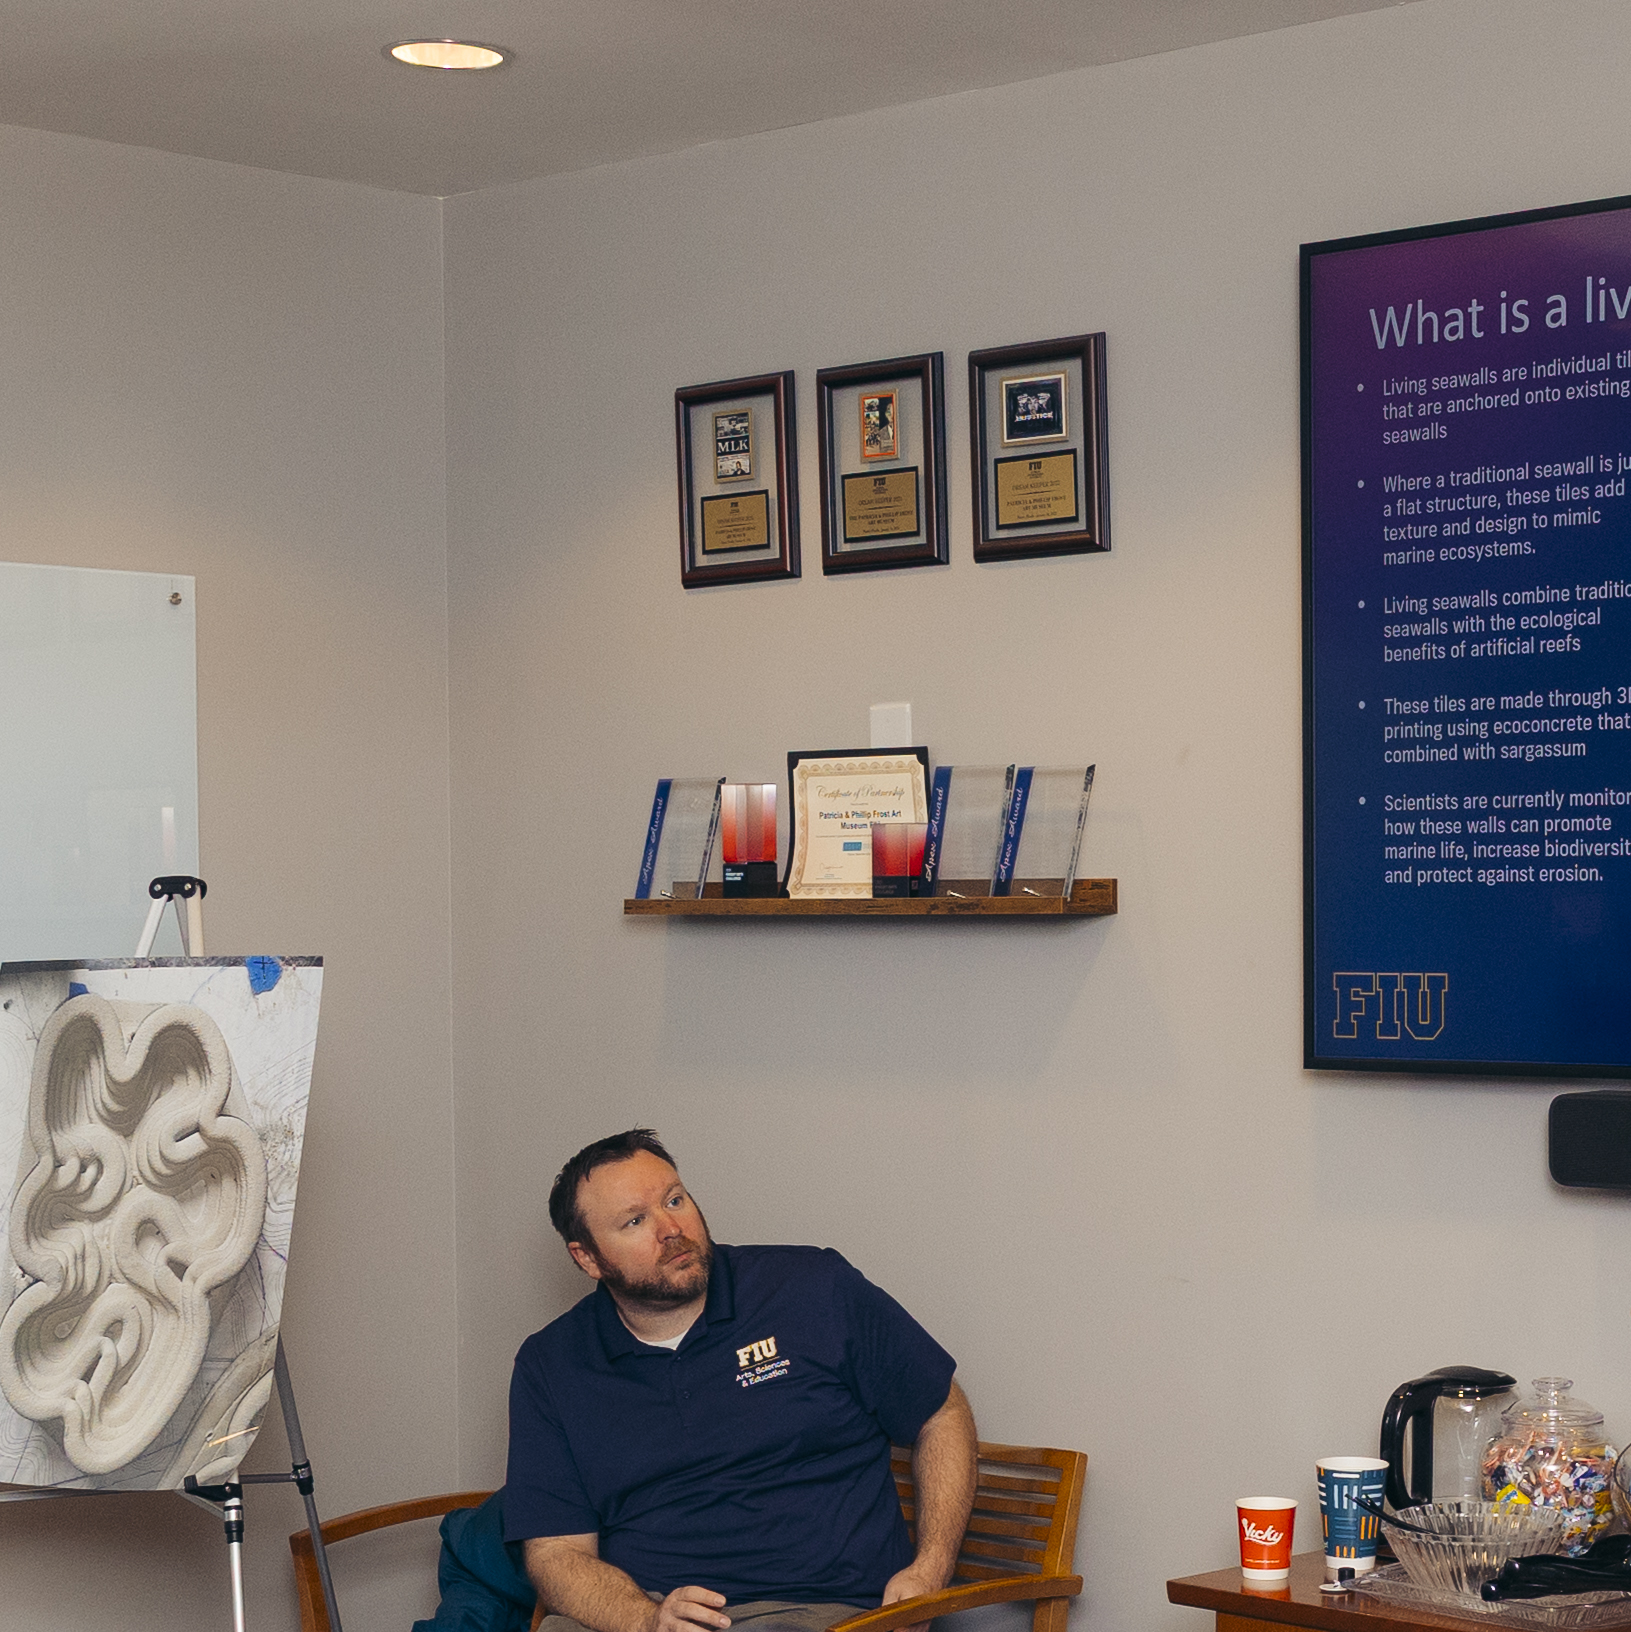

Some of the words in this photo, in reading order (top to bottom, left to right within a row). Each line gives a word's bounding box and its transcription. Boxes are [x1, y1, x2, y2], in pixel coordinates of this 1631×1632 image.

[1369, 298, 1484, 349] What
[1500, 290, 1530, 334] is
[1545, 294, 1567, 329] a
[1383, 376, 1427, 396] Living
[1432, 366, 1498, 390] seawalls
[1501, 369, 1528, 384] are
[1532, 352, 1610, 379] individual
[1382, 402, 1413, 420] that
[1418, 401, 1442, 416] are
[1447, 388, 1519, 413] anchored
[1525, 386, 1561, 405] onto
[1566, 377, 1631, 400] existing
[717, 438, 749, 453] MLK
[1383, 422, 1448, 445] seawalls
[1383, 474, 1431, 493] Where
[1436, 475, 1445, 488] a
[1449, 462, 1529, 487] traditional
[1534, 455, 1594, 479] seawall
[1600, 454, 1613, 472] is
[1383, 504, 1392, 517] a
[1396, 498, 1422, 516] flat
[1426, 494, 1501, 513] structure,
[1506, 488, 1550, 506] these
[1555, 483, 1590, 502] tiles
[1594, 478, 1625, 498] add
[1383, 524, 1438, 541] texture
[1442, 517, 1470, 536] and
[1475, 514, 1527, 535] design
[1532, 513, 1548, 529] to
[1553, 506, 1601, 527] mimic
[1383, 546, 1435, 565] marine
[1439, 541, 1536, 562] ecosystems.
[1384, 595, 1428, 615] Living
[1432, 589, 1498, 611] seawalls
[1502, 585, 1570, 606] combine
[1384, 617, 1448, 638] seawalls
[1452, 615, 1485, 634] with
[1490, 613, 1516, 631] the
[1520, 606, 1601, 631] ecological
[1384, 642, 1446, 662] benefits
[1450, 640, 1466, 658] of
[1470, 636, 1534, 657] artificial
[1540, 633, 1581, 653] reefs
[1383, 697, 1429, 715] These
[1433, 694, 1466, 713] tiles
[1470, 697, 1495, 711] are
[1500, 690, 1544, 709] made
[1548, 686, 1612, 709] through
[1384, 720, 1443, 743] printing
[1447, 718, 1489, 739] using
[1493, 715, 1592, 735] ecoconcrete
[1597, 712, 1631, 730] that
[1384, 743, 1458, 763] combined
[1462, 742, 1495, 760] with
[1500, 742, 1586, 762] sargassum
[819, 811, 843, 820] Patricia
[844, 811, 850, 819] &
[872, 810, 890, 818] Frost
[891, 809, 902, 818] Art
[1384, 793, 1459, 811] Scientists
[1463, 796, 1488, 809] are
[1492, 789, 1565, 811] currently
[840, 821, 868, 830] Museum
[1384, 818, 1415, 835] how
[1419, 817, 1462, 835] these
[1466, 815, 1506, 834] walls
[1510, 819, 1539, 833] can
[1544, 814, 1612, 836] promote
[1385, 842, 1436, 859] marine
[1440, 841, 1468, 861] life,
[1473, 841, 1540, 858] increase
[1384, 866, 1412, 883] and
[1417, 867, 1473, 887] protect
[1477, 864, 1535, 886] against
[1539, 863, 1603, 882] erosion.
[1333, 972, 1448, 1040] FIU
[736, 1336, 777, 1367] FIU
[1241, 1517, 1284, 1546] Vicky
